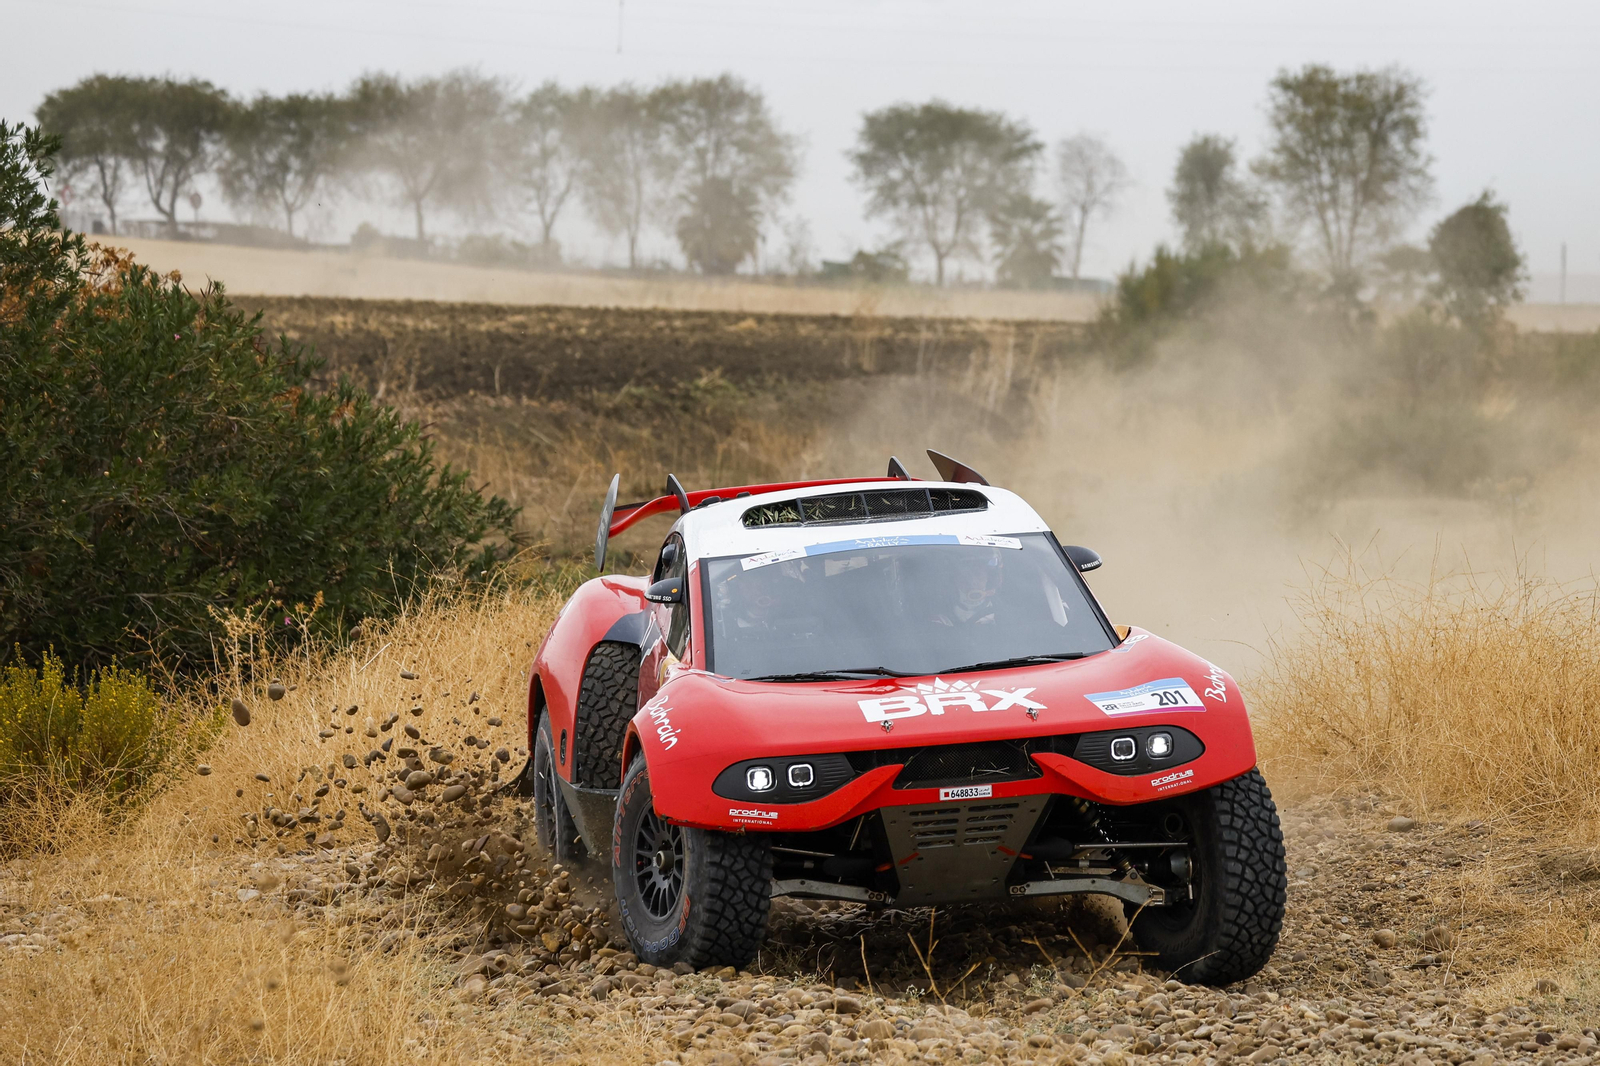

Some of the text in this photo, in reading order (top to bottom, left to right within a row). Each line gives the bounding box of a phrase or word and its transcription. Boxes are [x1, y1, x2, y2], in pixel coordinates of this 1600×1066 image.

[857, 687, 1049, 723] BRX
[1151, 690, 1188, 706] 201
[648, 695, 682, 751] Bahrain
[1151, 769, 1194, 787] prodrive
[1157, 779, 1192, 792] INTERNATIONAL
[950, 788, 979, 799] 648833
[729, 809, 778, 819] prodrive
[733, 818, 773, 826] INTERNATIONAL
